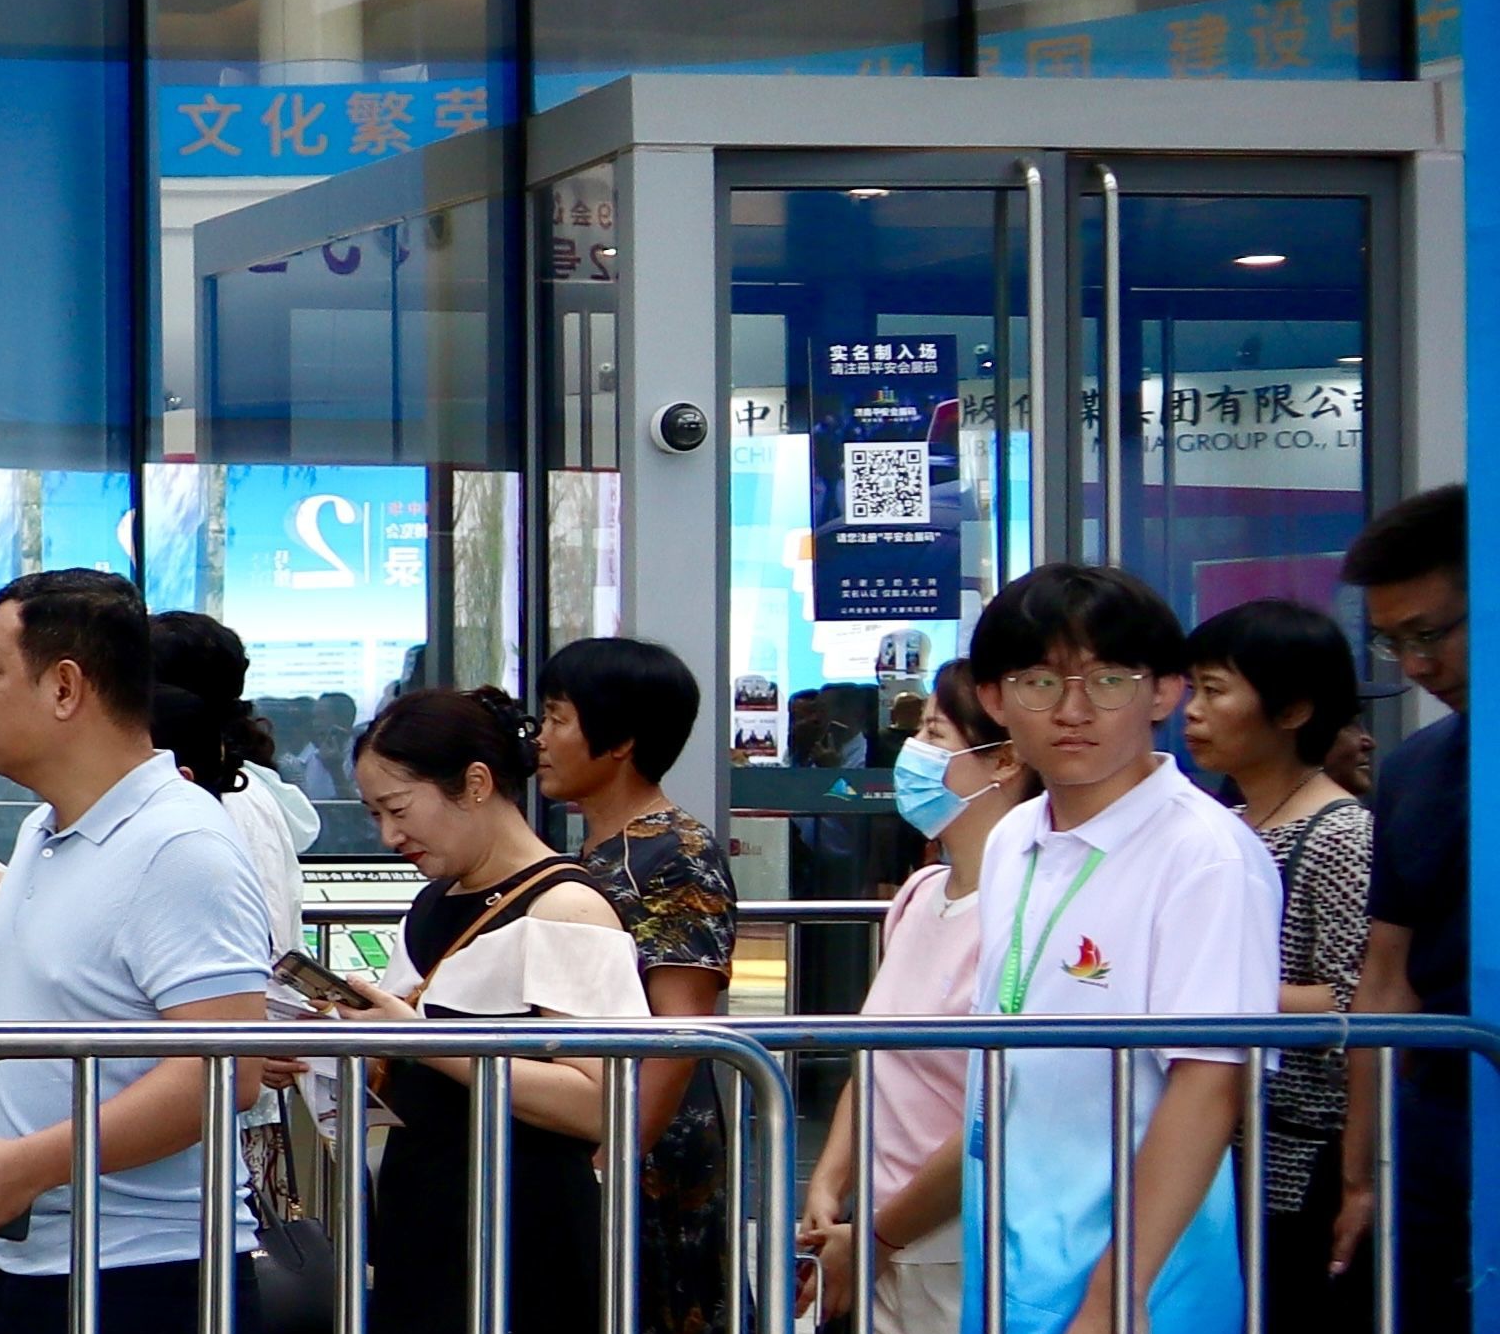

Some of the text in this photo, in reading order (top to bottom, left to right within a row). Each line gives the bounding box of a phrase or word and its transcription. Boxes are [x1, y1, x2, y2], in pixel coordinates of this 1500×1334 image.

[829, 343, 938, 361] 实名制入场
[830, 361, 938, 375] 请注册平安会展码
[1176, 431, 1268, 453] GROUP
